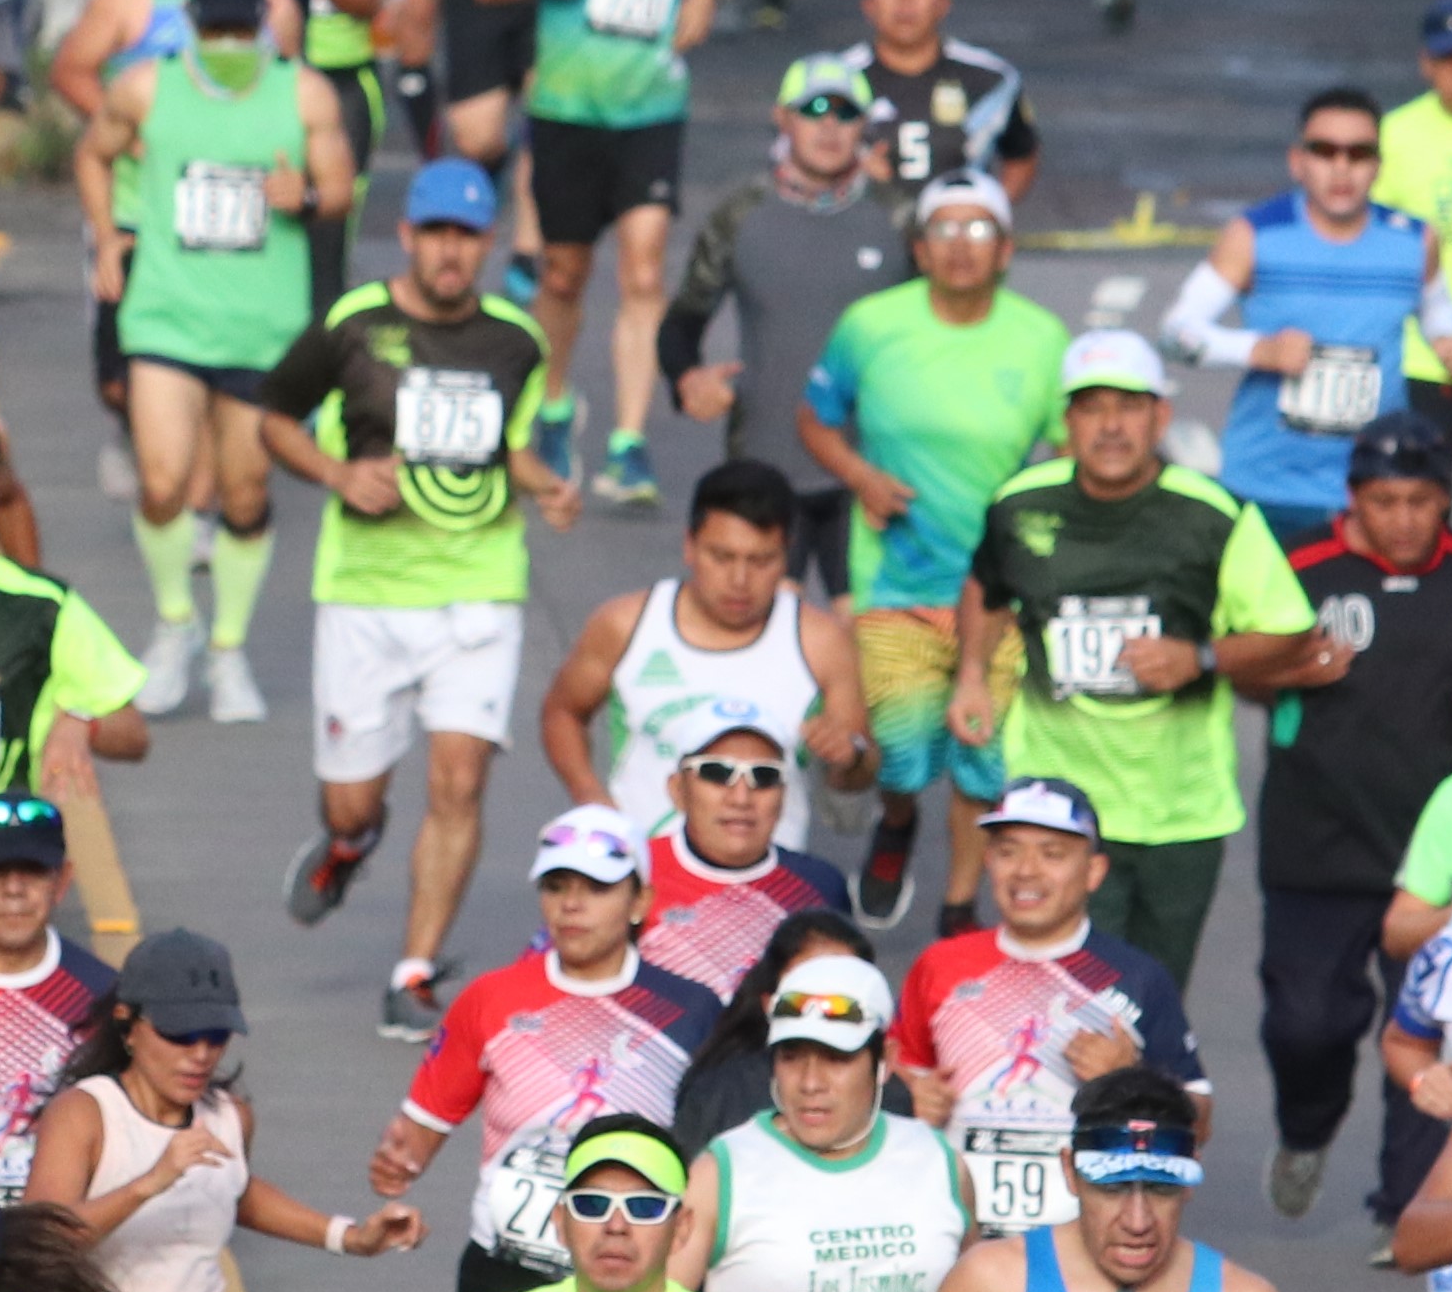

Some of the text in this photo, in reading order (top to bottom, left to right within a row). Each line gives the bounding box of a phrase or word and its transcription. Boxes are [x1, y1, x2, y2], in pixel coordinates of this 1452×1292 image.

[898, 122, 930, 180] 5
[414, 402, 485, 449] 875
[993, 1162, 1045, 1217] 59
[809, 1224, 915, 1245] CENTRO
[815, 1242, 917, 1262] MEDICO
